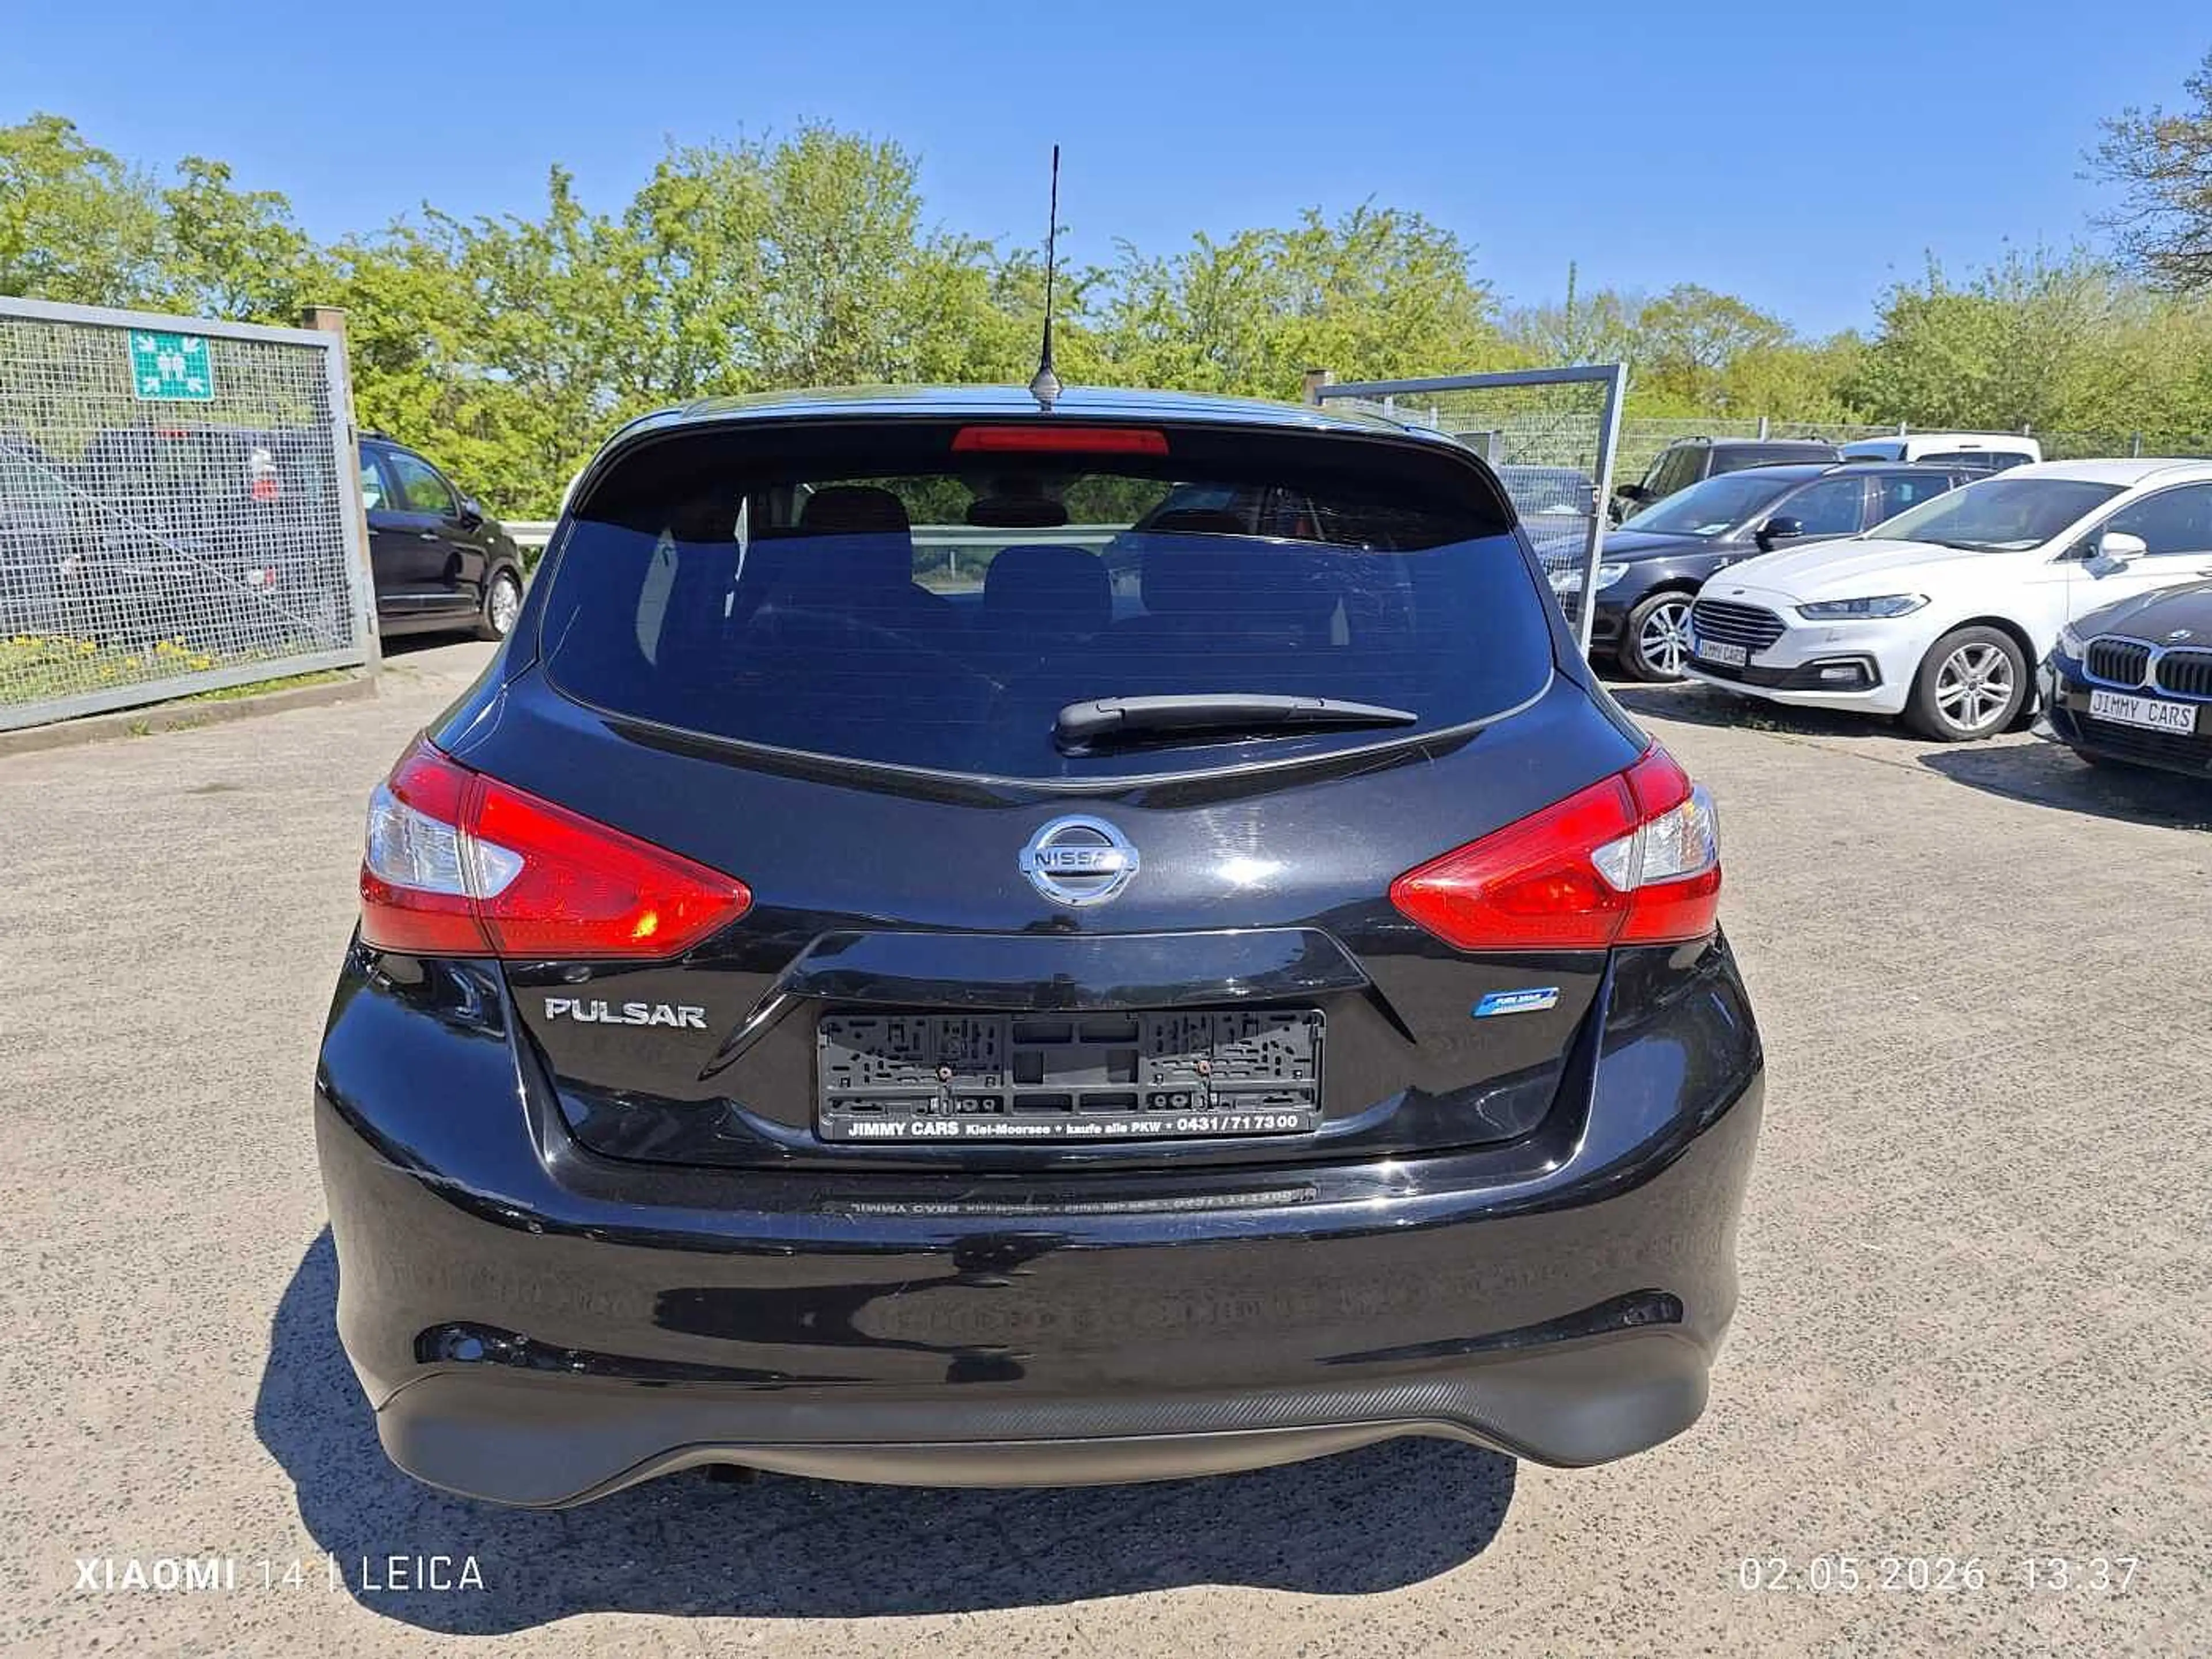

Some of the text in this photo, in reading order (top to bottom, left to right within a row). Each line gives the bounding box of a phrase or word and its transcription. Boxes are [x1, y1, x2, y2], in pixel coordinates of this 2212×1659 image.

[2093, 694, 2191, 728] JIMMY CARS
[544, 998, 708, 1028] PULSAR
[848, 1122, 906, 1136] JIMMY
[911, 1122, 959, 1136] CARS
[1131, 1122, 1162, 1132] PKW
